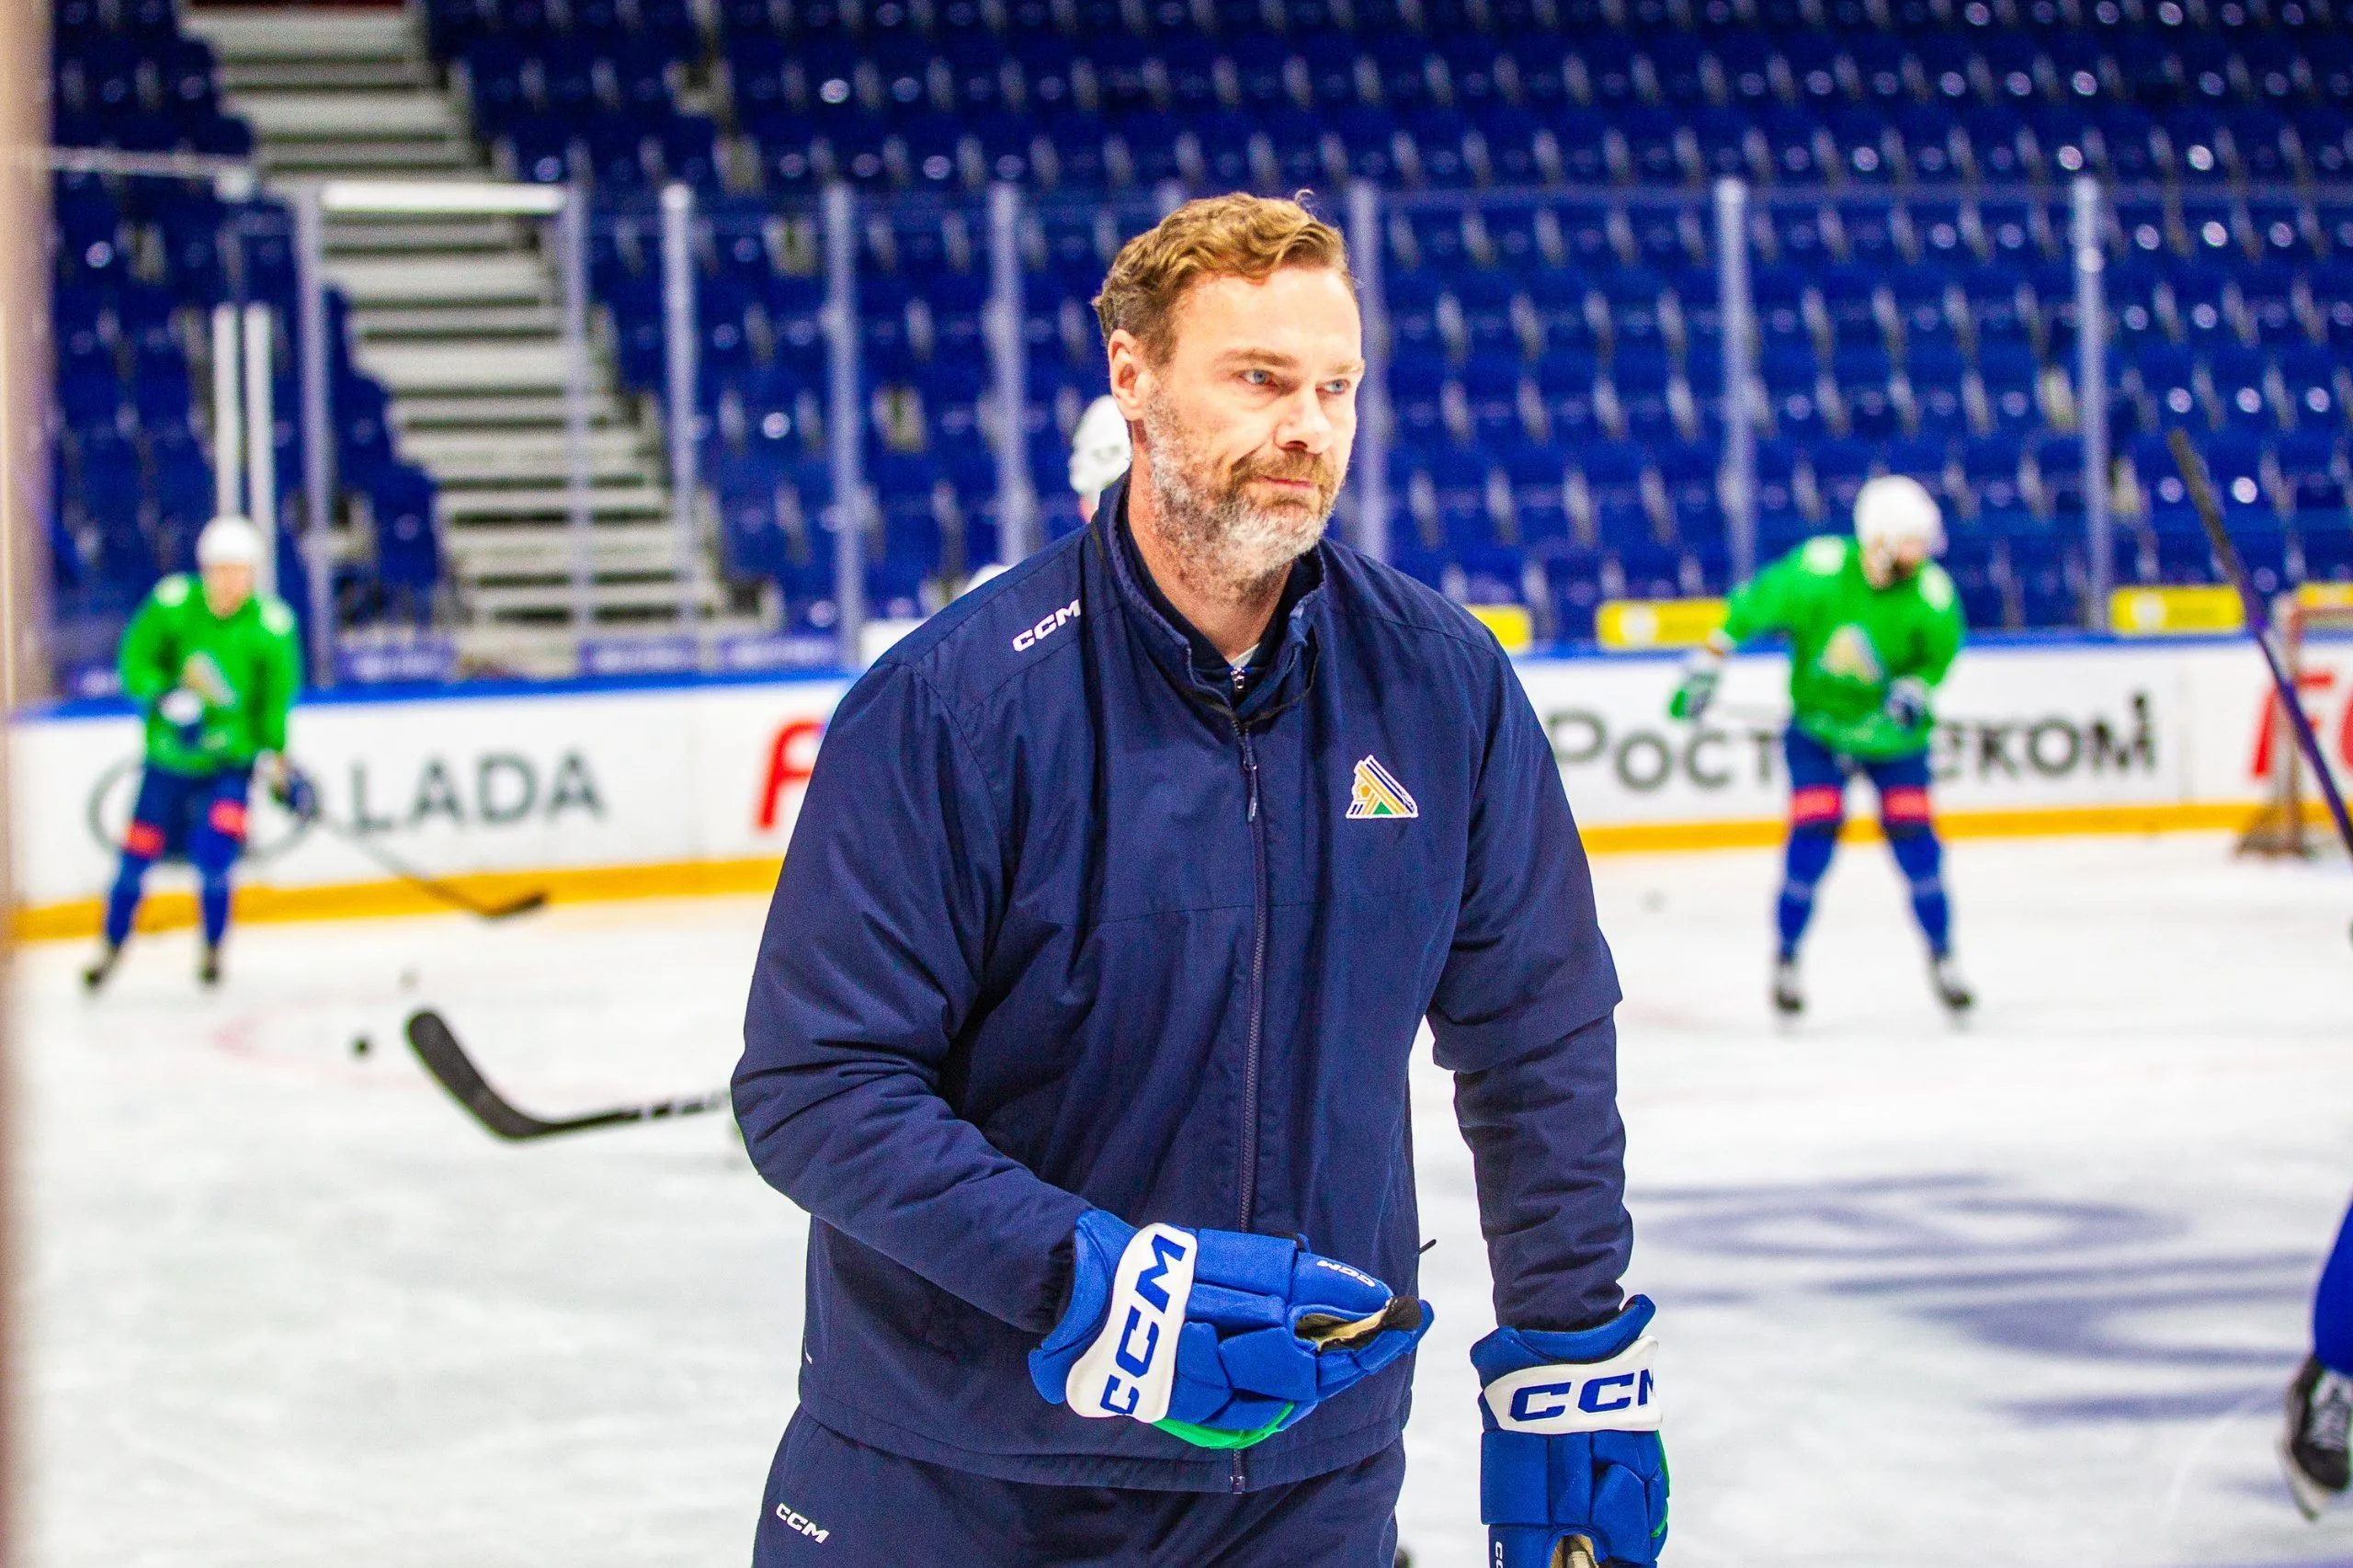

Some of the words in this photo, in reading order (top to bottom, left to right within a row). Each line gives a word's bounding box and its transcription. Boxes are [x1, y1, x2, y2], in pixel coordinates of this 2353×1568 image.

[1012, 598, 1082, 652] CCM
[347, 750, 608, 832] LADA
[1100, 1233, 1186, 1415] CCM
[776, 1503, 830, 1544] CCM
